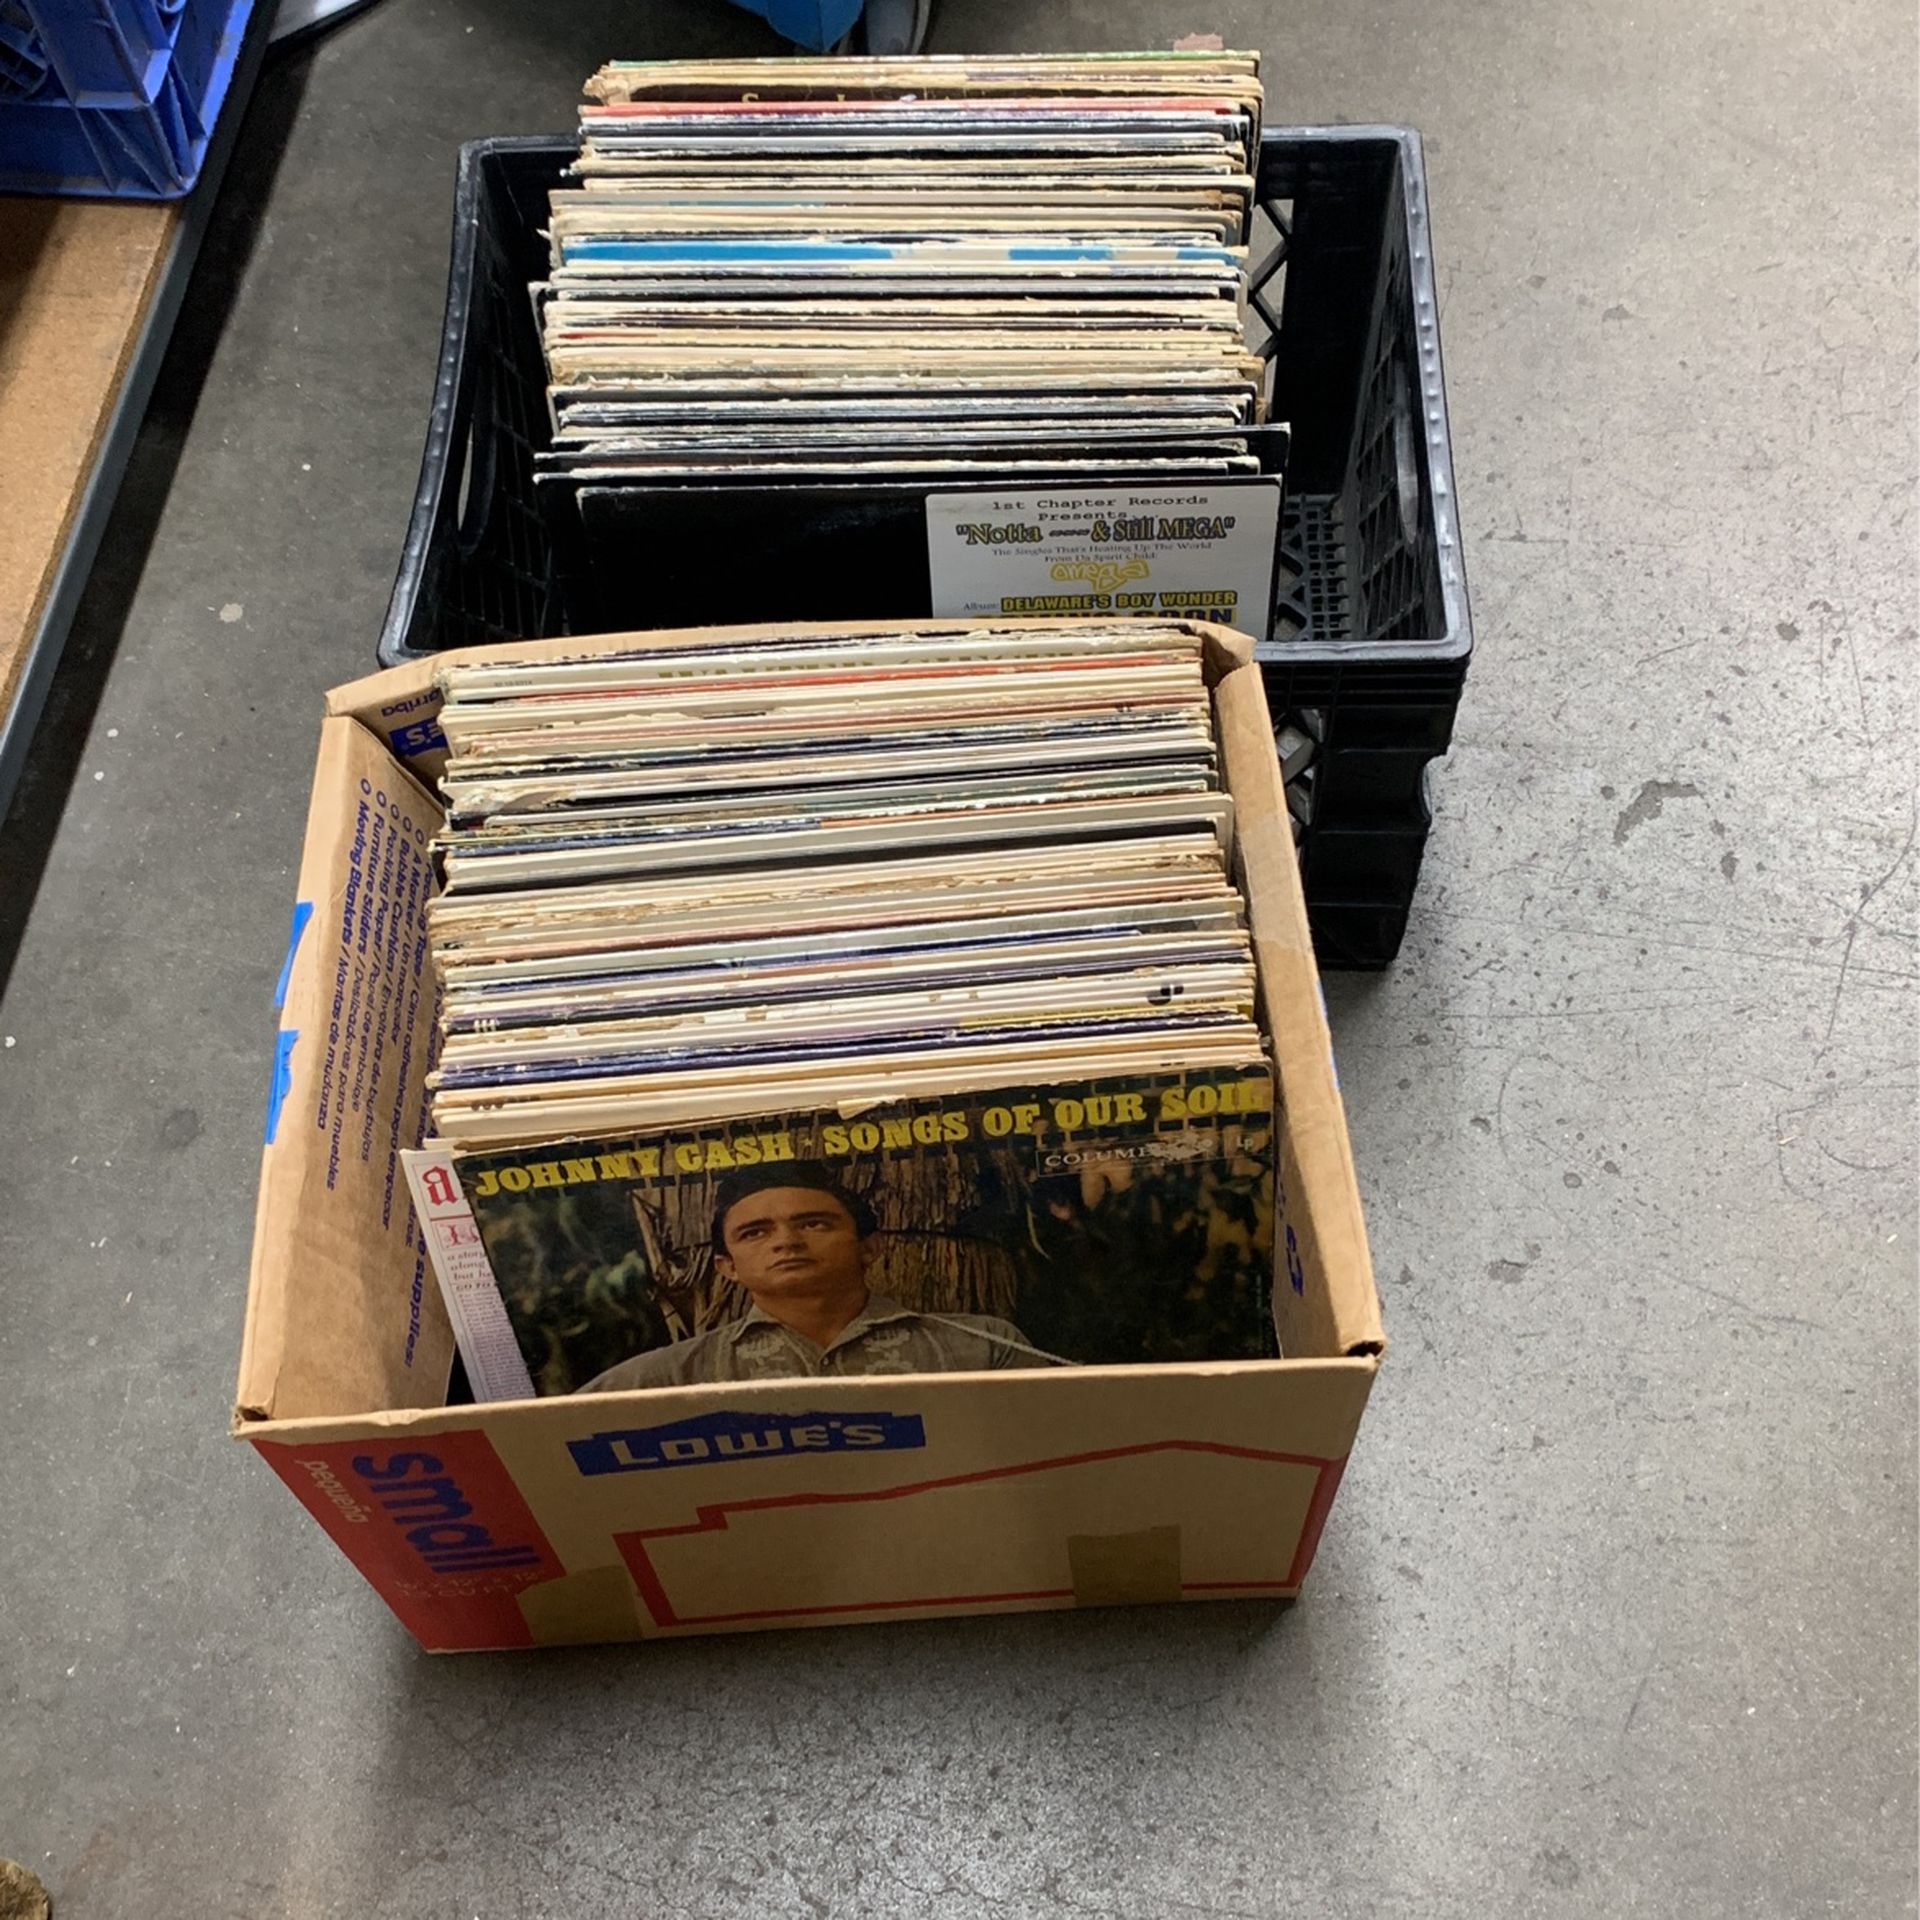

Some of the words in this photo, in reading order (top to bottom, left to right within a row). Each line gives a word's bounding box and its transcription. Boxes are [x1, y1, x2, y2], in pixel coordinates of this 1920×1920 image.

[993, 501, 1025, 510] 1st
[1037, 499, 1117, 511] Chapter
[1128, 495, 1208, 506] Records
[1038, 511, 1127, 521] Presents
[1091, 519, 1110, 542] &
[1113, 516, 1154, 541] Still
[1157, 516, 1236, 540] MEGA"
[993, 548, 1011, 556] The
[1134, 543, 1151, 554] Up
[1154, 542, 1173, 550] The
[1177, 540, 1211, 549] World
[1001, 594, 1111, 612] DELAWARE'S
[1115, 592, 1156, 608] BOY
[1159, 590, 1238, 606] WONDER
[381, 687, 441, 717] arriba
[350, 799, 370, 867] Moving
[366, 812, 385, 893] Furniture
[380, 825, 398, 896] Packing
[413, 850, 423, 865] A
[395, 838, 410, 898] Bubble
[405, 866, 421, 930] Marker
[417, 862, 434, 931] Packng
[342, 866, 362, 945] Blankets
[357, 894, 374, 955] Sliders
[374, 897, 389, 952] Paper
[386, 901, 403, 972] Cushion
[400, 943, 412, 965] Un
[414, 935, 427, 977] Tape
[332, 957, 349, 1021] Mantas
[366, 962, 381, 1010] Papel
[329, 1022, 340, 1045] de
[342, 967, 365, 1071] Deslizadores
[363, 1011, 373, 1033] de
[318, 1047, 336, 1130] mudanza
[336, 1071, 348, 1114] para
[371, 1062, 381, 1084] de
[327, 1116, 343, 1191] muebles
[361, 1086, 378, 1161] burbujas
[475, 1146, 661, 1196] JOHNNY
[674, 1131, 795, 1172] CASH
[822, 1110, 970, 1156] SONGS
[982, 1103, 1041, 1138] OF
[1054, 1092, 1148, 1131] OUR
[1159, 1081, 1266, 1118] SOIL
[608, 1421, 887, 1466] LOWE'S
[294, 1459, 370, 1524] pequeño
[352, 1452, 541, 1574] small
